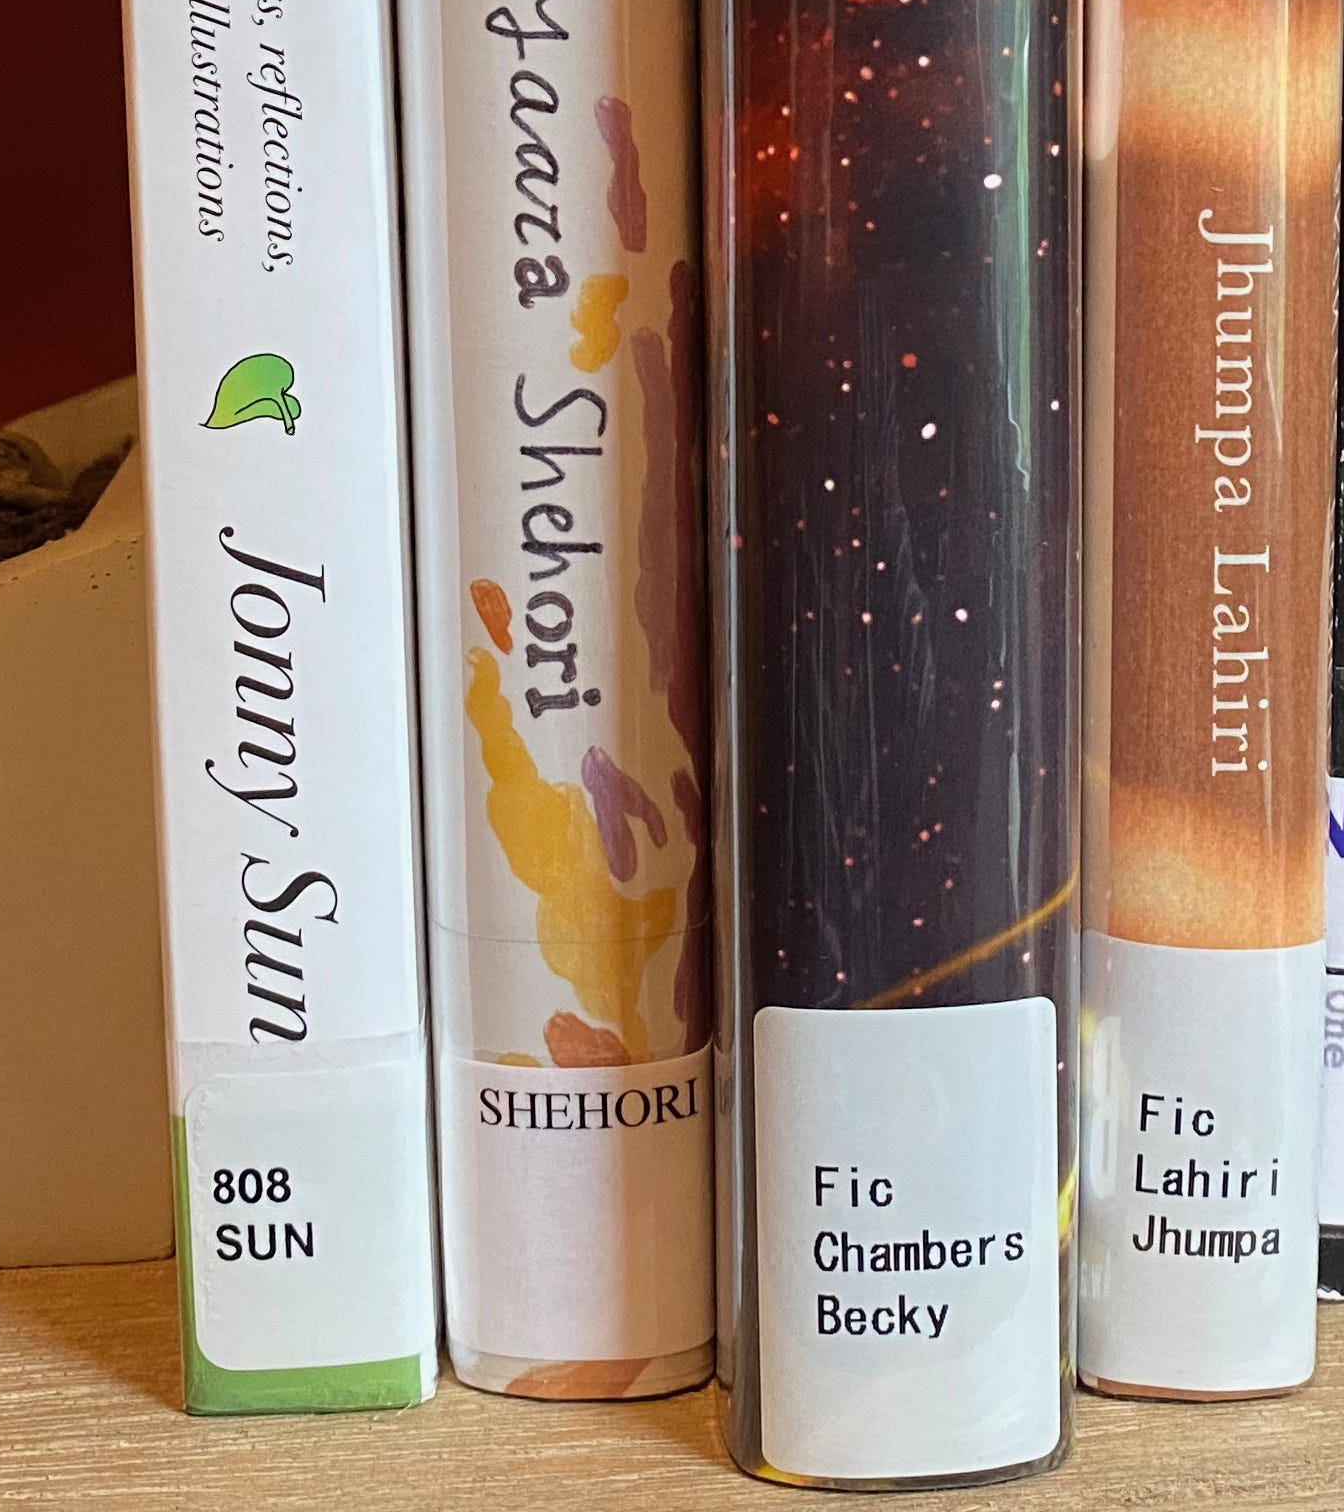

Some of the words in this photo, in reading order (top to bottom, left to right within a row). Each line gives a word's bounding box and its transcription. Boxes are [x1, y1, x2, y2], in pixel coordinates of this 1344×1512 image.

[246, 42, 304, 273] reflections,
[1194, 206, 1275, 514] Jhumpa
[513, 374, 608, 720] Shehori
[205, 526, 327, 839] Jonny
[1211, 544, 1270, 778] Lahiri
[241, 852, 340, 1044] Sun
[480, 1078, 699, 1130] SHEHORI
[1139, 1093, 1216, 1138] Fic
[212, 1166, 292, 1204] 808
[815, 1166, 894, 1208] Fic
[1135, 1153, 1280, 1199] Lahiri
[216, 1222, 314, 1261] SUN
[813, 1229, 1025, 1274] Chambers
[1132, 1215, 1281, 1264] Jhumpa
[817, 1294, 949, 1338] Becky
